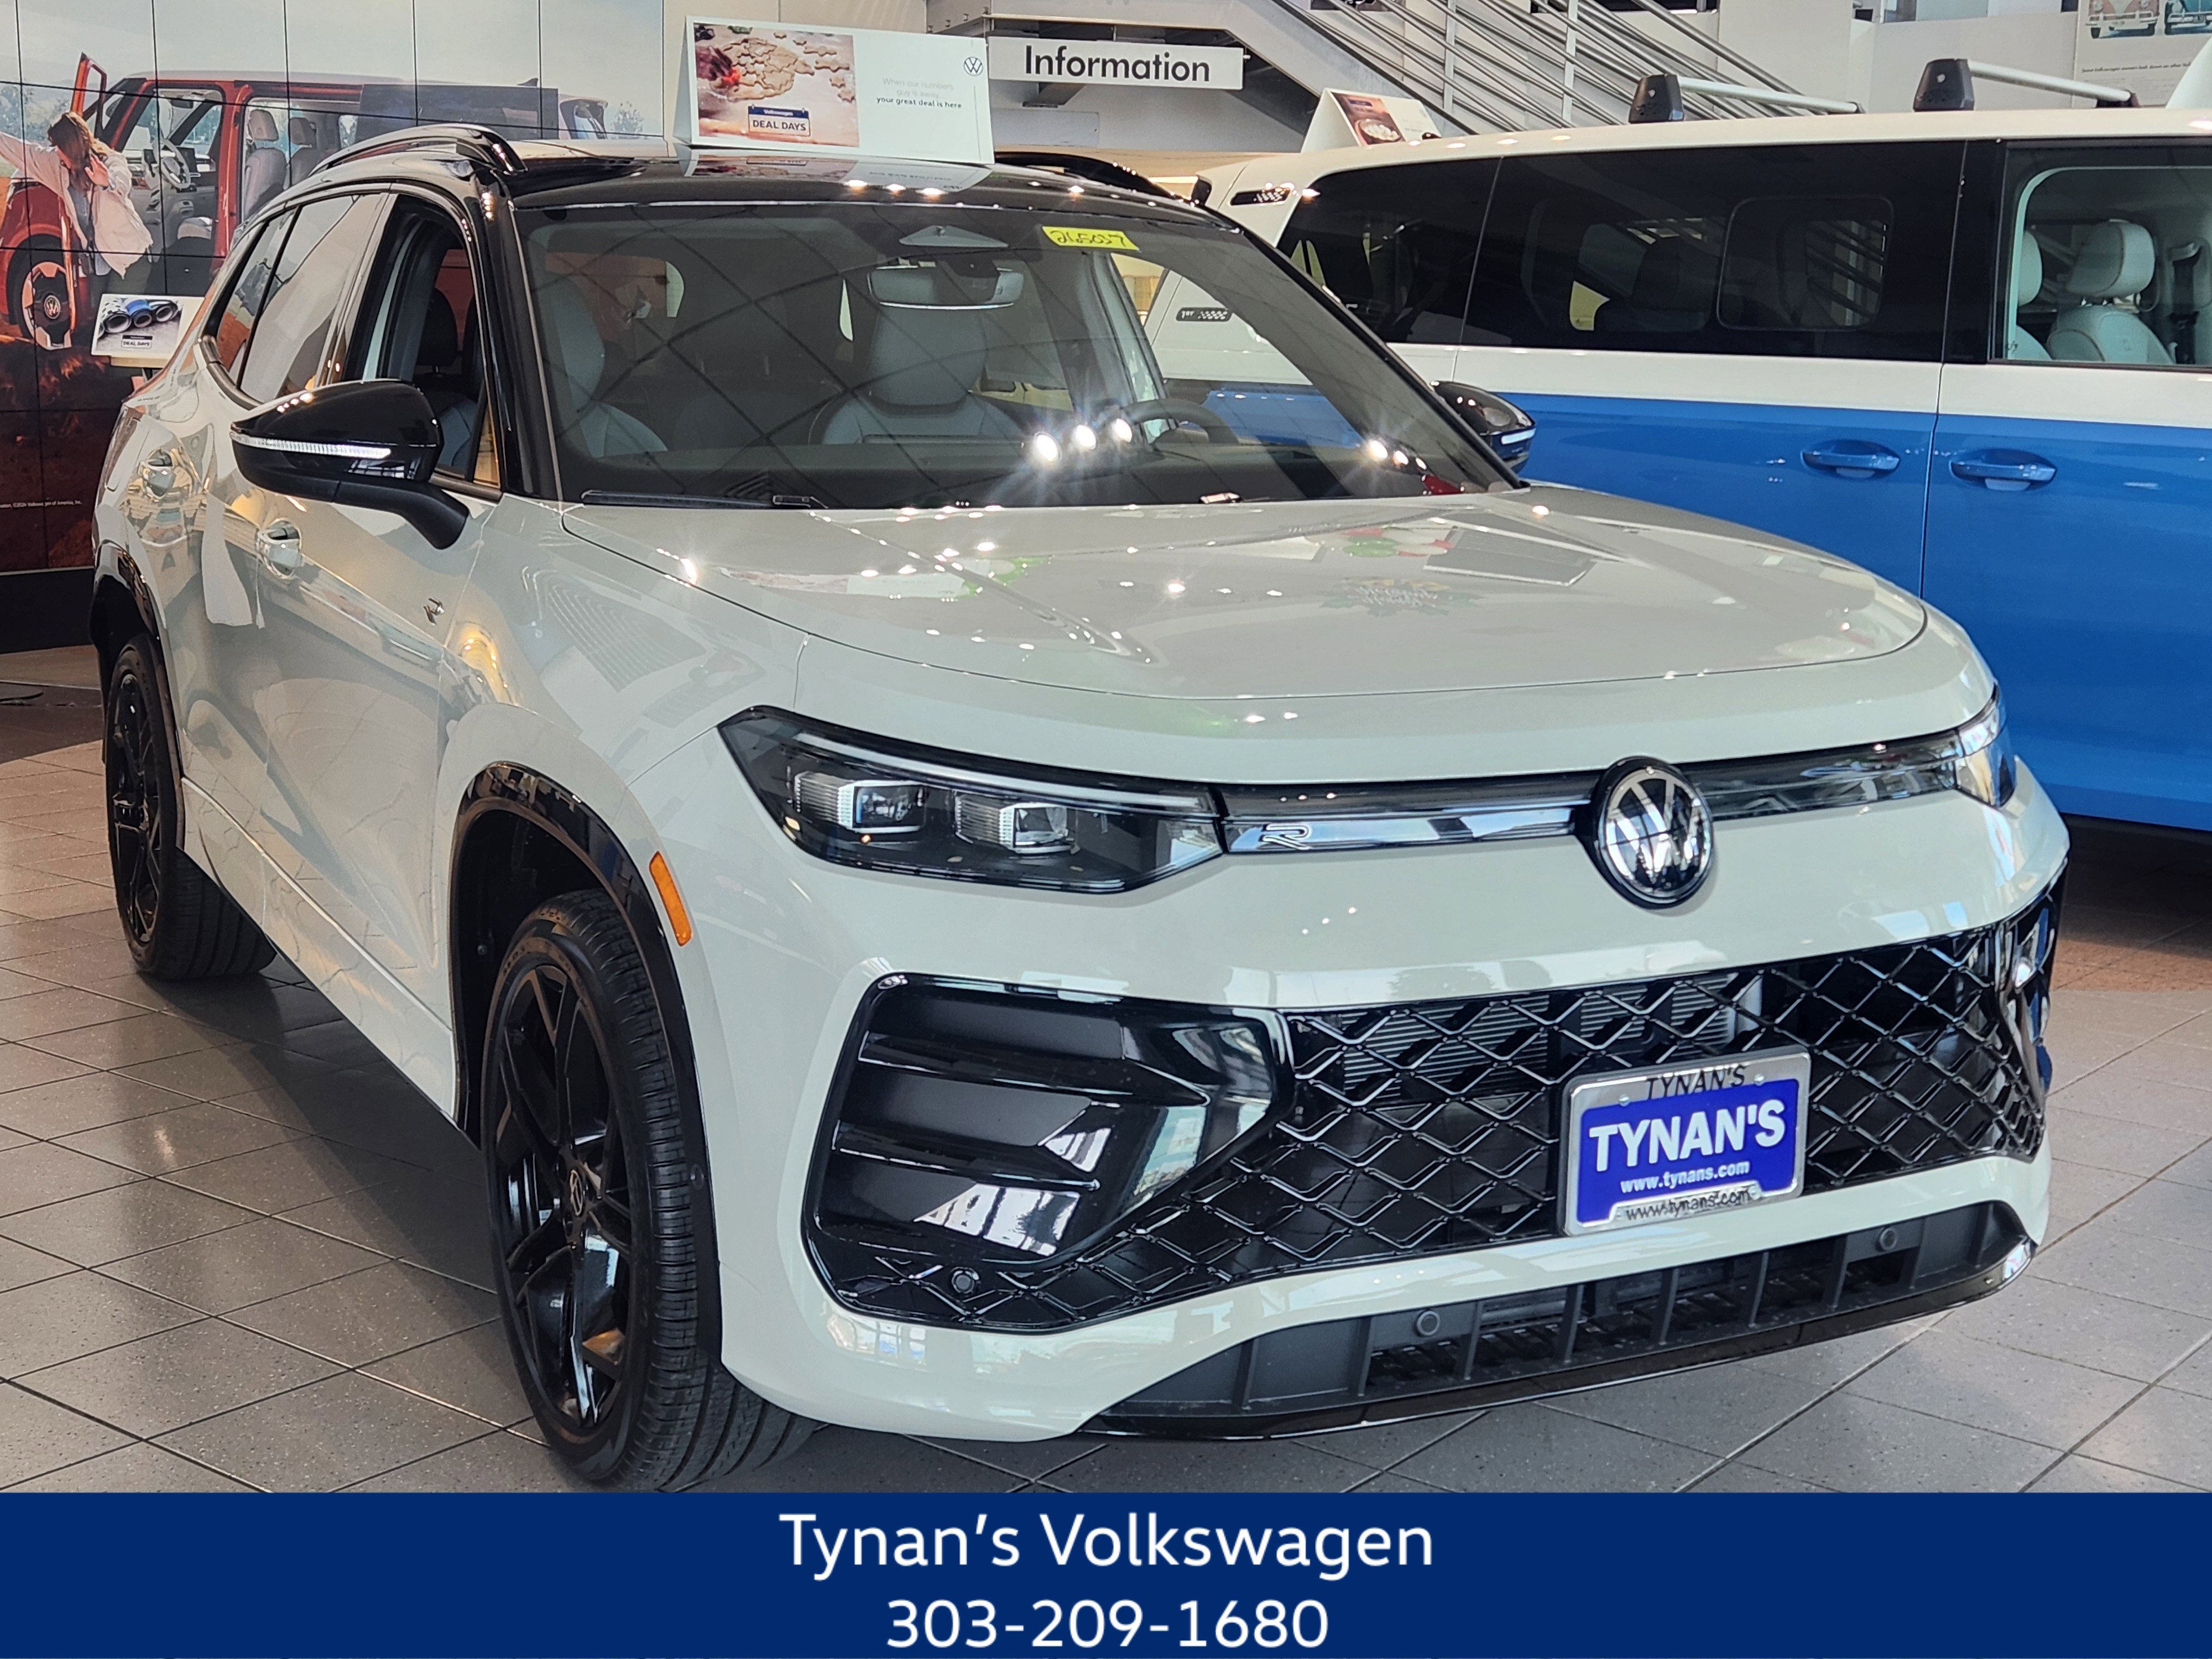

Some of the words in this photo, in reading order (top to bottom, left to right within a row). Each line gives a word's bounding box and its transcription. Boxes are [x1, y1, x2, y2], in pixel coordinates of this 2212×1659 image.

[1025, 45, 1210, 82] Information
[882, 77, 905, 86] When
[919, 99, 935, 107] deal
[753, 119, 779, 129] DEAL
[781, 122, 806, 131] DAYS
[1645, 1065, 1746, 1100] TYNAN'S
[1589, 1099, 1786, 1172] TYNAN'S
[1620, 1161, 1750, 1194] www.tynans.com
[1626, 1189, 1751, 1221] www.tynans.com
